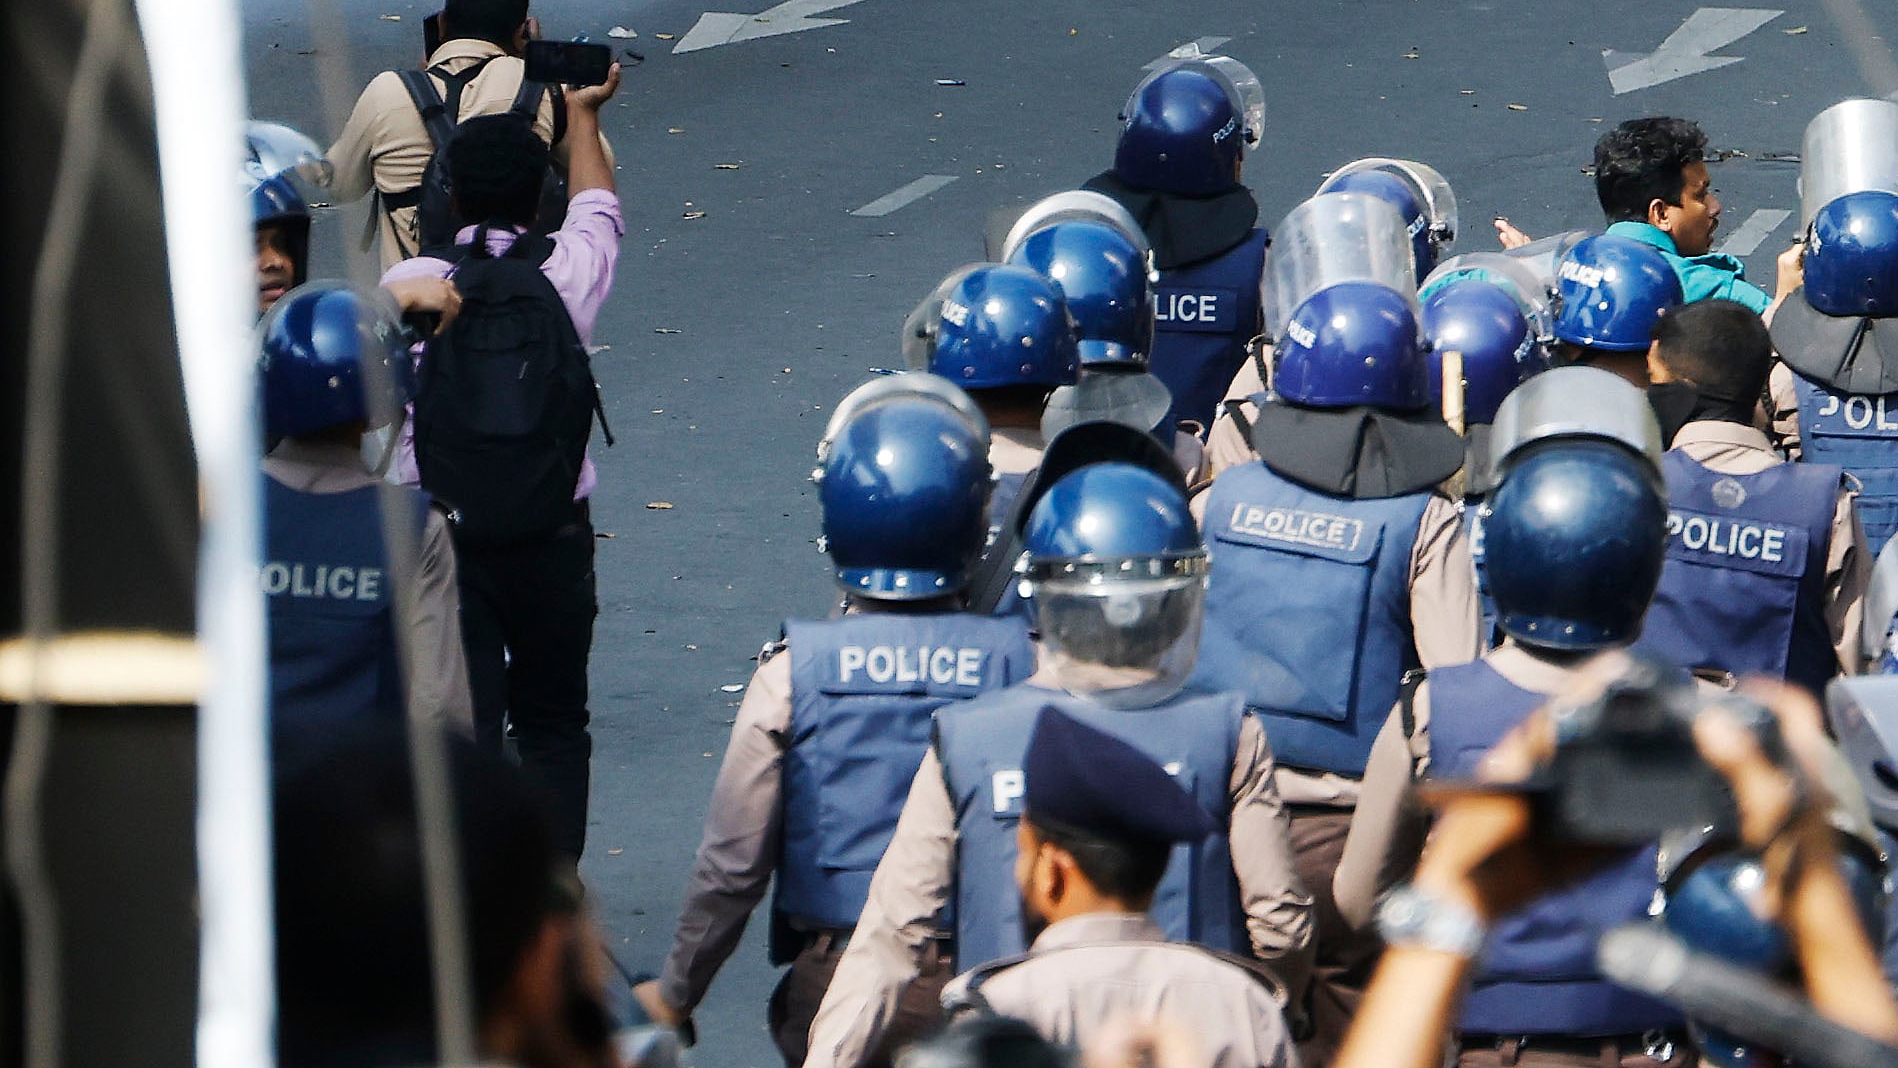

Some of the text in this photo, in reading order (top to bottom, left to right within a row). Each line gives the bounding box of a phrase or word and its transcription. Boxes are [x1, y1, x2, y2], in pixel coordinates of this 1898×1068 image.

[1154, 294, 1218, 323] LICE
[1246, 506, 1347, 544] POLICE
[260, 563, 381, 601] OLICE
[839, 645, 982, 686] POLICE
